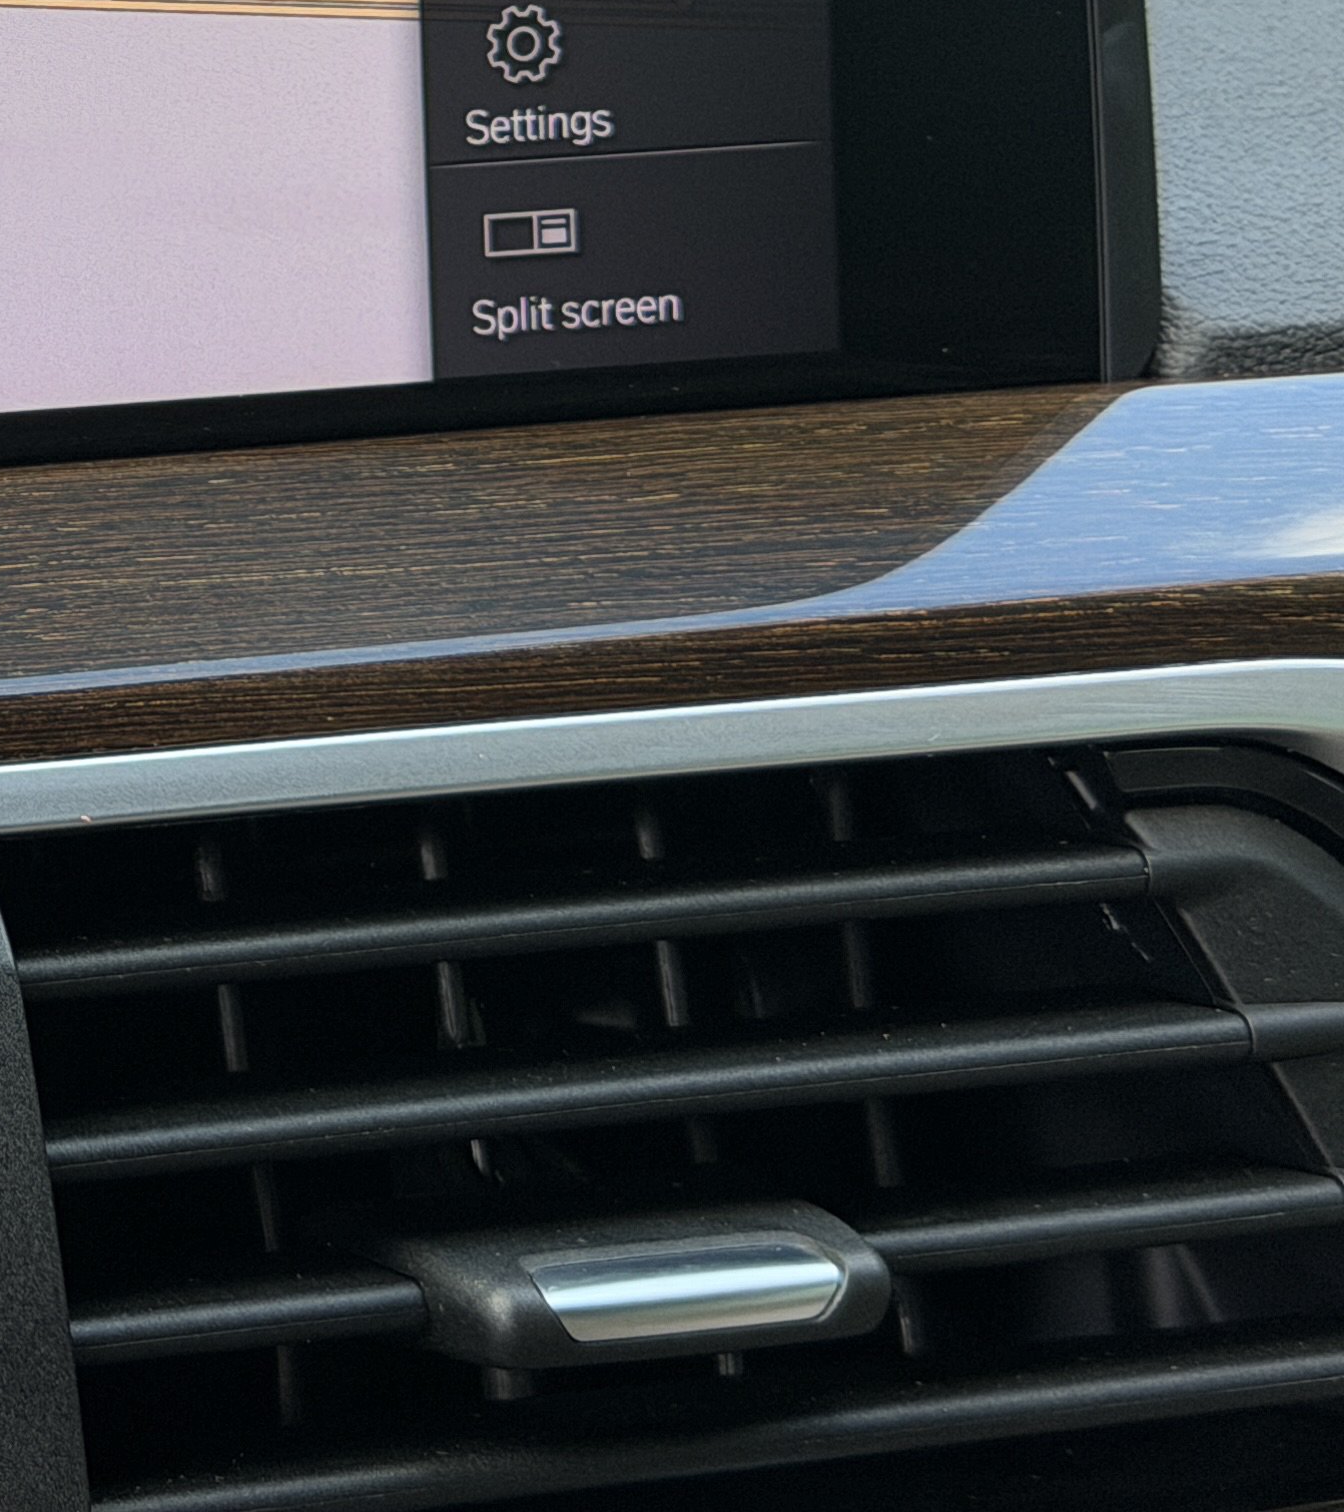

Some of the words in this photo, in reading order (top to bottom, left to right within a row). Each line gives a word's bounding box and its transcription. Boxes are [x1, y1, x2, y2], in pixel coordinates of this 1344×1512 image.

[466, 106, 612, 145] Settings
[473, 297, 553, 340] Split
[562, 295, 679, 329] screen
